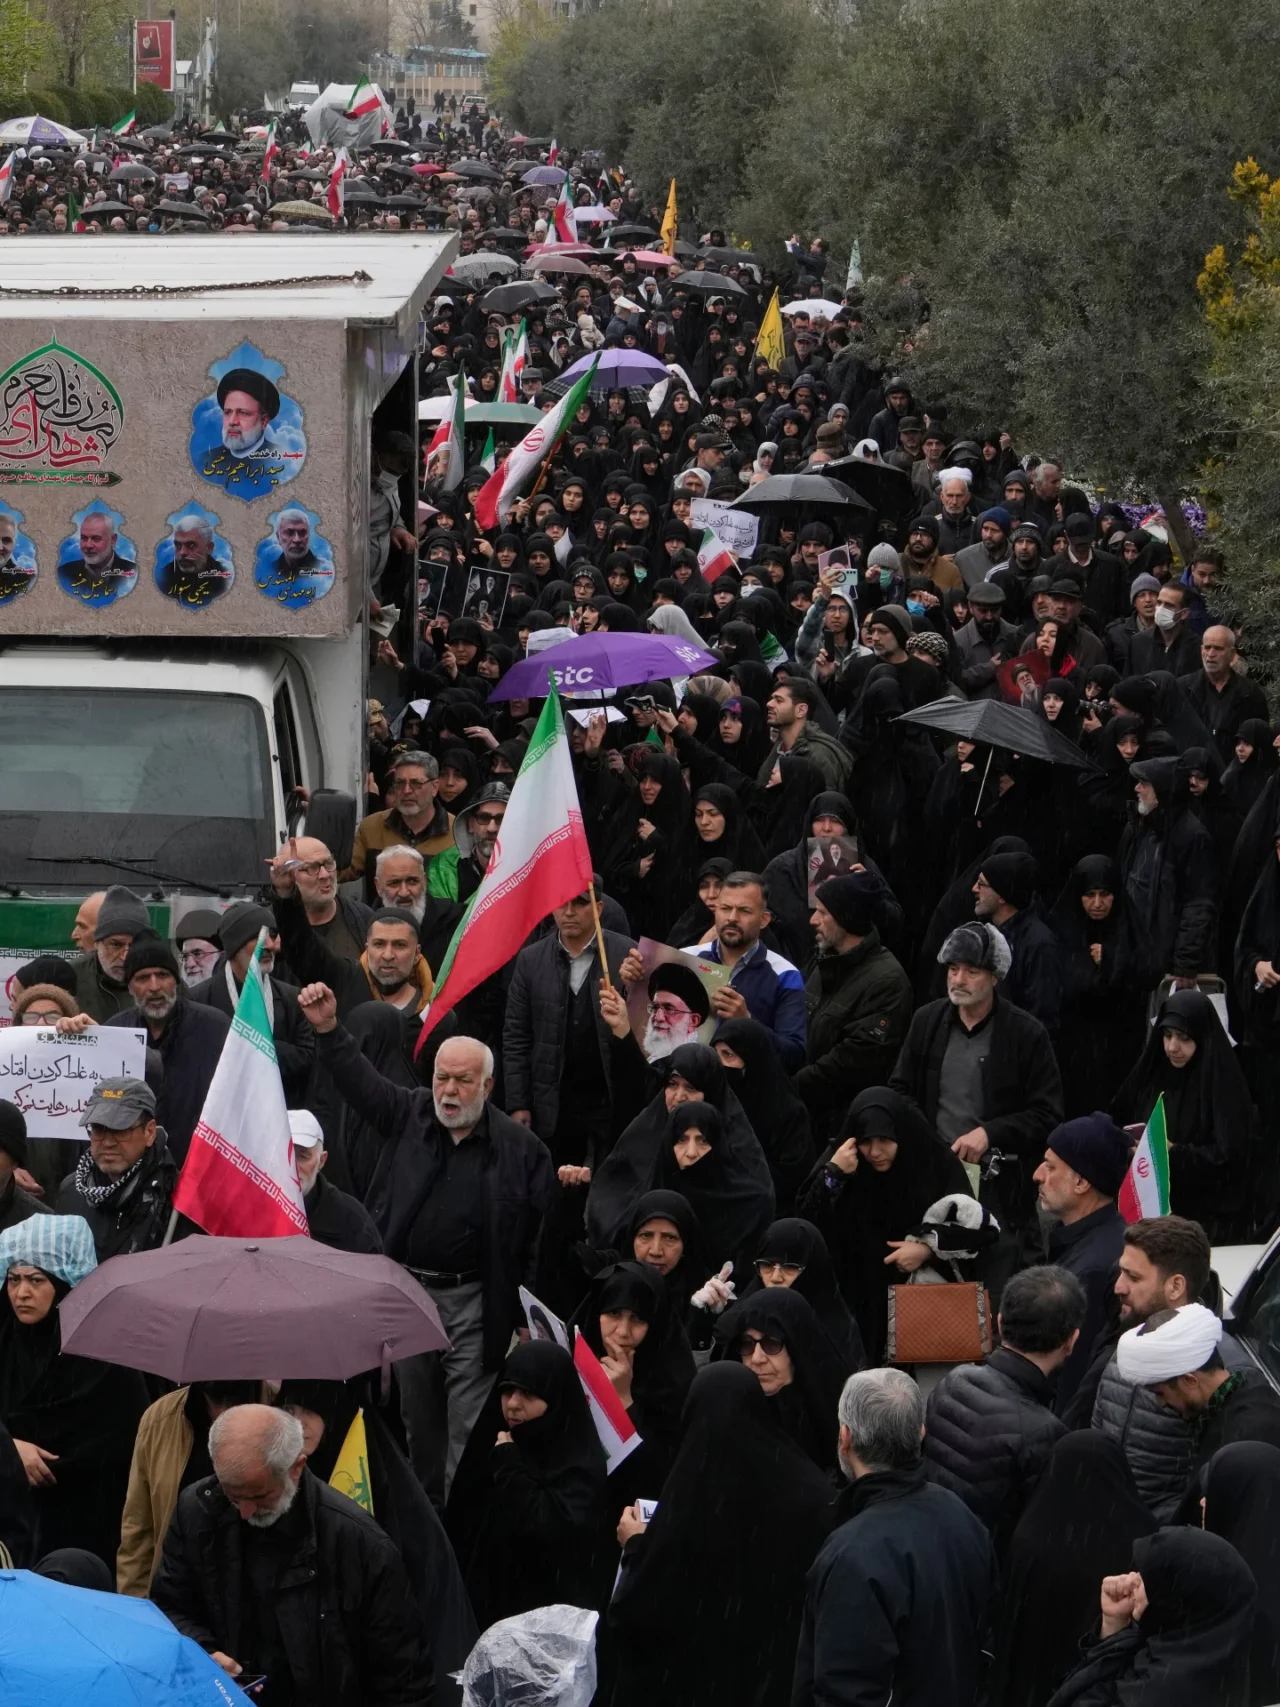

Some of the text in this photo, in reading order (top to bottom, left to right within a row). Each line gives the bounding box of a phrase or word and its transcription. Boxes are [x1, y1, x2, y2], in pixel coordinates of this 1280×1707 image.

[248, 449, 304, 461] شهید راه خدمت
[0, 472, 109, 485] قرارگاه جهادی شهدای مدافع حرم
[226, 461, 265, 487] ابراهیم
[266, 465, 285, 485] سید
[82, 579, 117, 599] اسماعیل
[167, 577, 210, 604] یحیی سنوار
[676, 645, 701, 663] stc
[548, 666, 593, 687] stc
[0, 1053, 28, 1077] افتاد
[27, 1054, 71, 1084] کردن
[64, 1057, 88, 1079] غلط
[88, 1070, 100, 1085] به
[32, 1088, 70, 1117] رهایت
